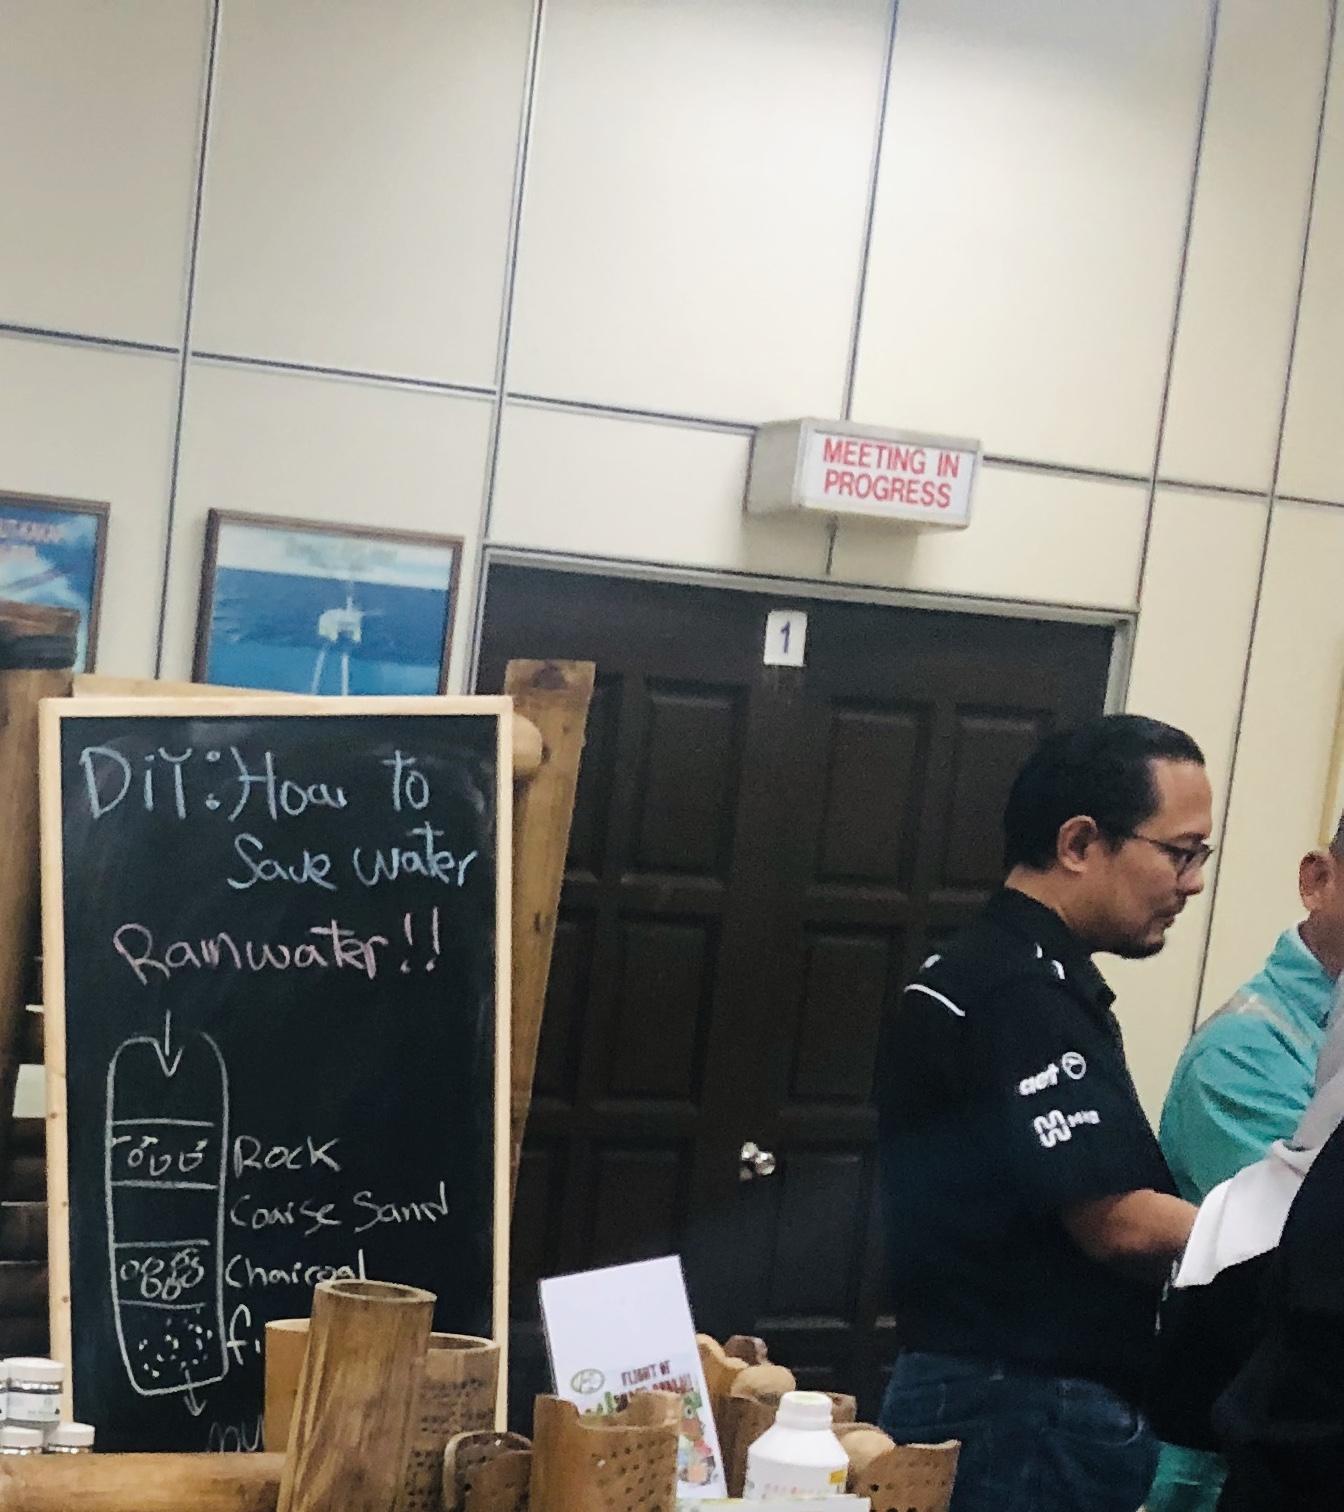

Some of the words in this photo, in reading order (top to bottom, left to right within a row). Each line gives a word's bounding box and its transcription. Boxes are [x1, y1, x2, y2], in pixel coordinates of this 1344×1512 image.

[823, 437, 926, 474] MEETING
[937, 452, 960, 478] IN
[823, 469, 952, 508] PROGRESS
[780, 620, 791, 653] 1
[227, 833, 337, 891] Save
